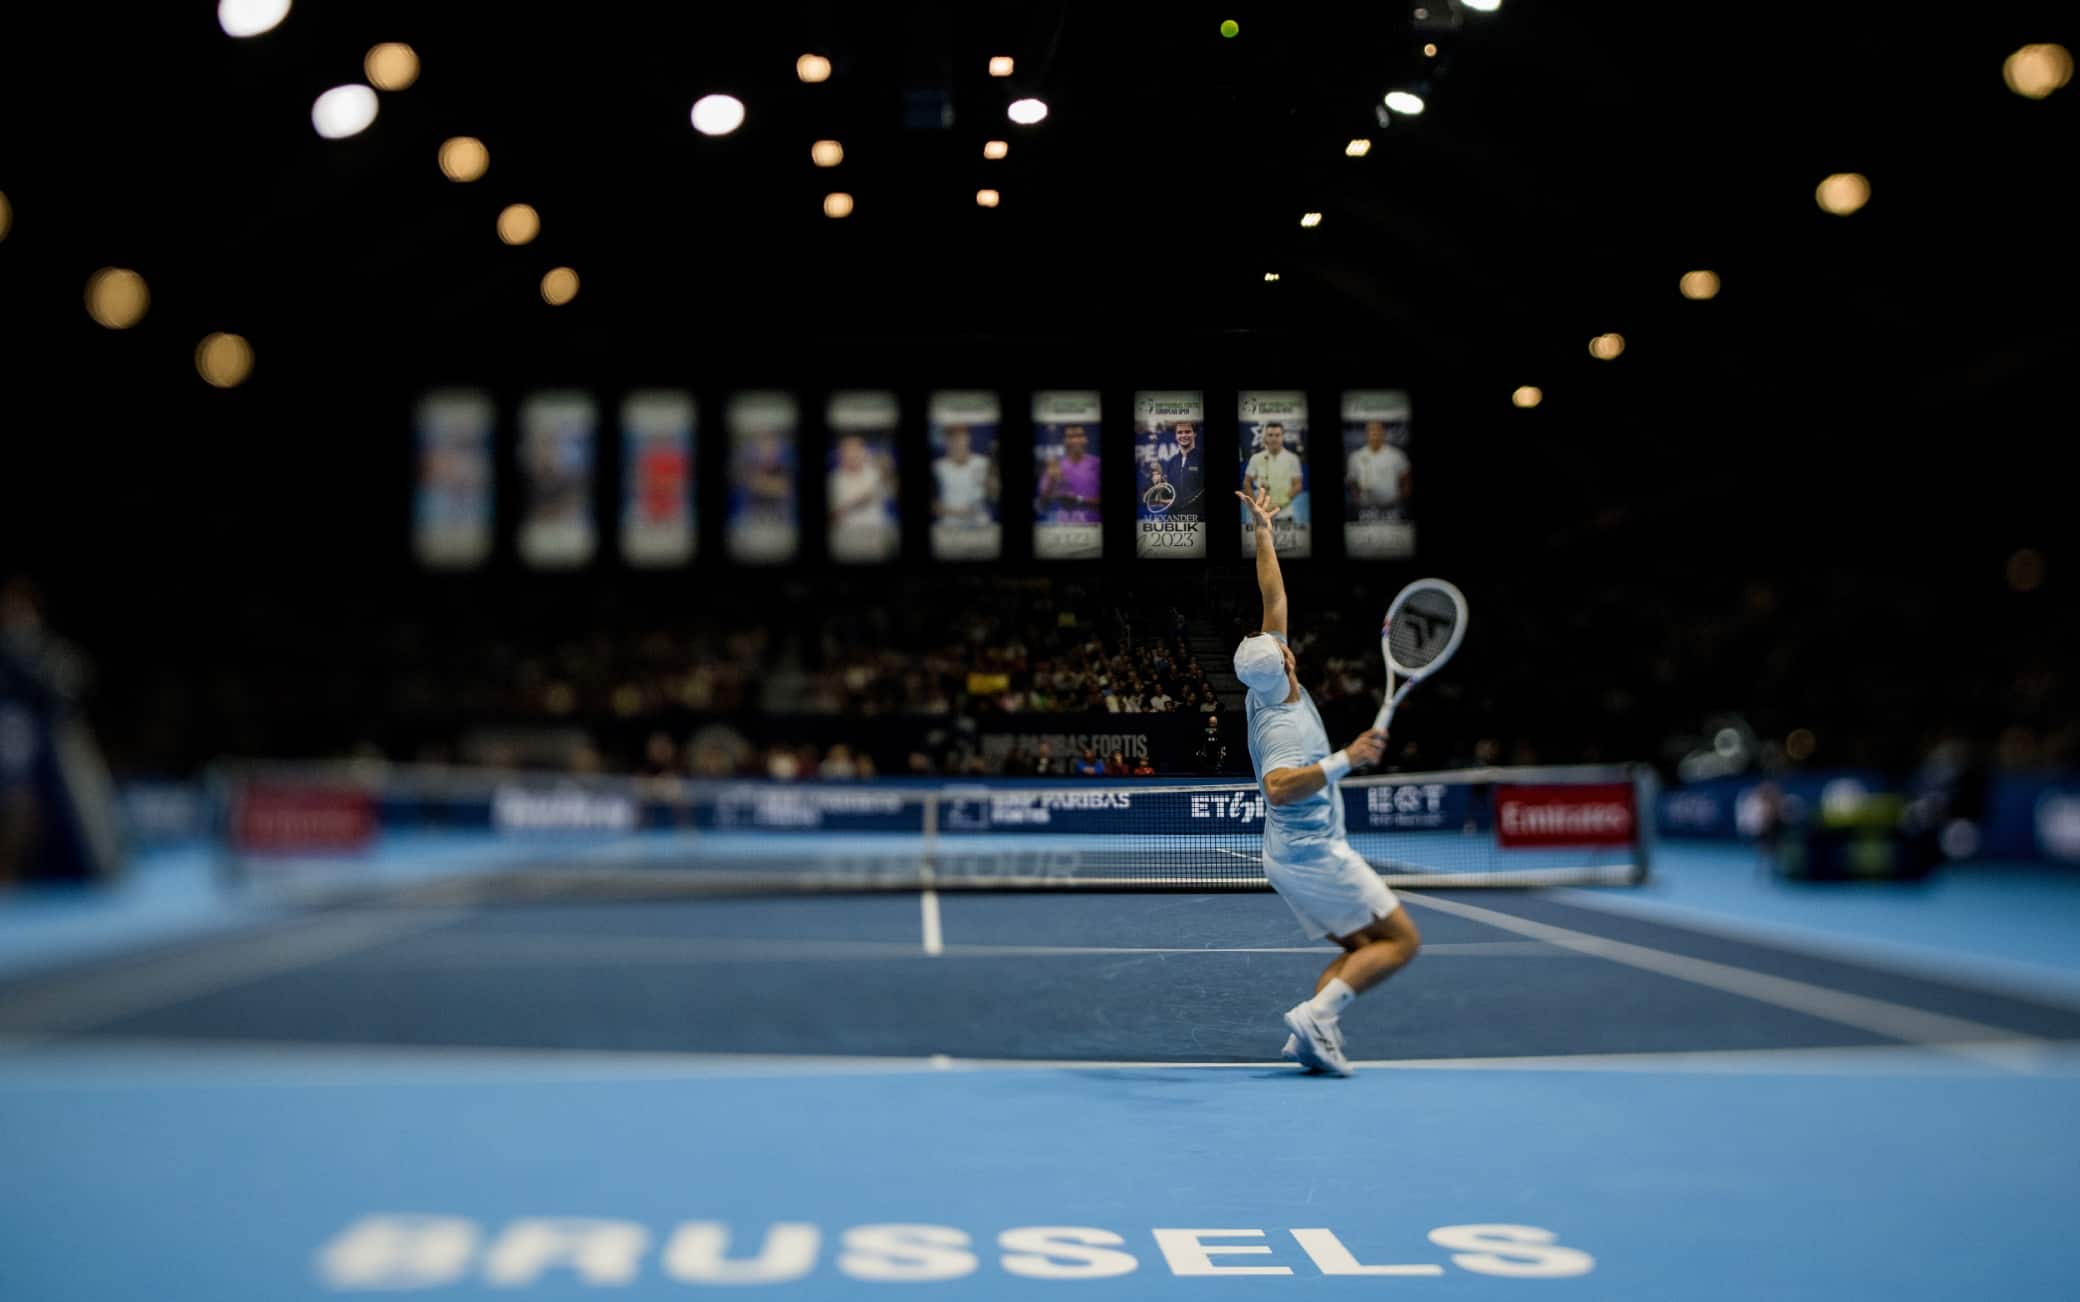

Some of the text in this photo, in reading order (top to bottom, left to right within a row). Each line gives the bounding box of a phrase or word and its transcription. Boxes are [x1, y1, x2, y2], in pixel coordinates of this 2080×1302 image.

[1143, 514, 1199, 522] ALEXANDER
[1143, 523, 1198, 532] BUBLIK
[1151, 533, 1194, 547] 2023
[1092, 734, 1149, 760] FORTIS
[1041, 792, 1130, 809] PARIBAS
[320, 1218, 1597, 1288] BRUSSELS
